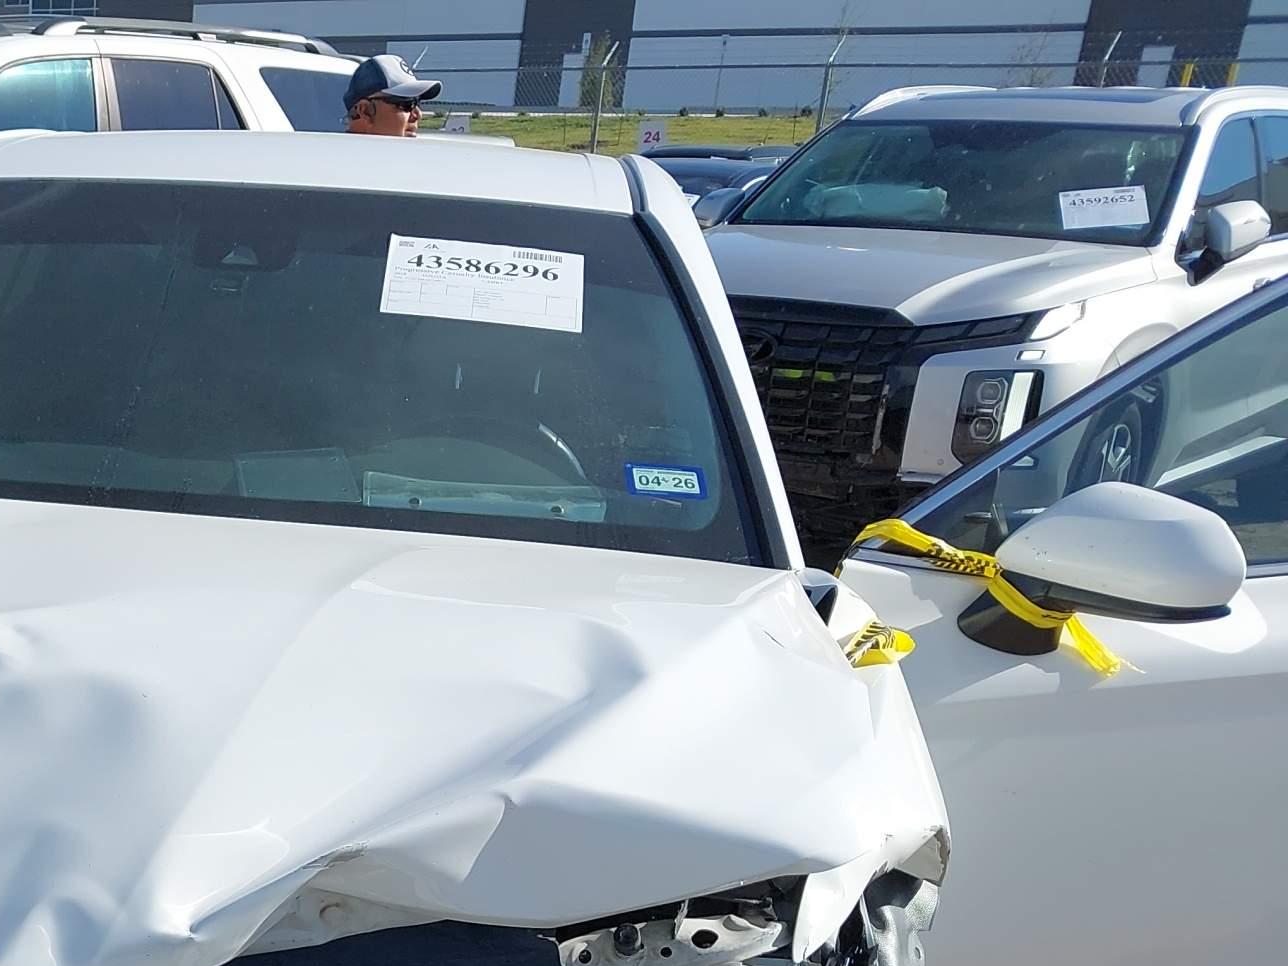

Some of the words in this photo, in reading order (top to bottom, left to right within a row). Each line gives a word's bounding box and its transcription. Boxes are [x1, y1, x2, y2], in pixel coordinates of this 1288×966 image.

[643, 131, 661, 143] 24
[1069, 194, 1136, 207] 43592652
[407, 253, 560, 281] 43586296
[638, 474, 662, 487] 04
[672, 477, 696, 489] 26
